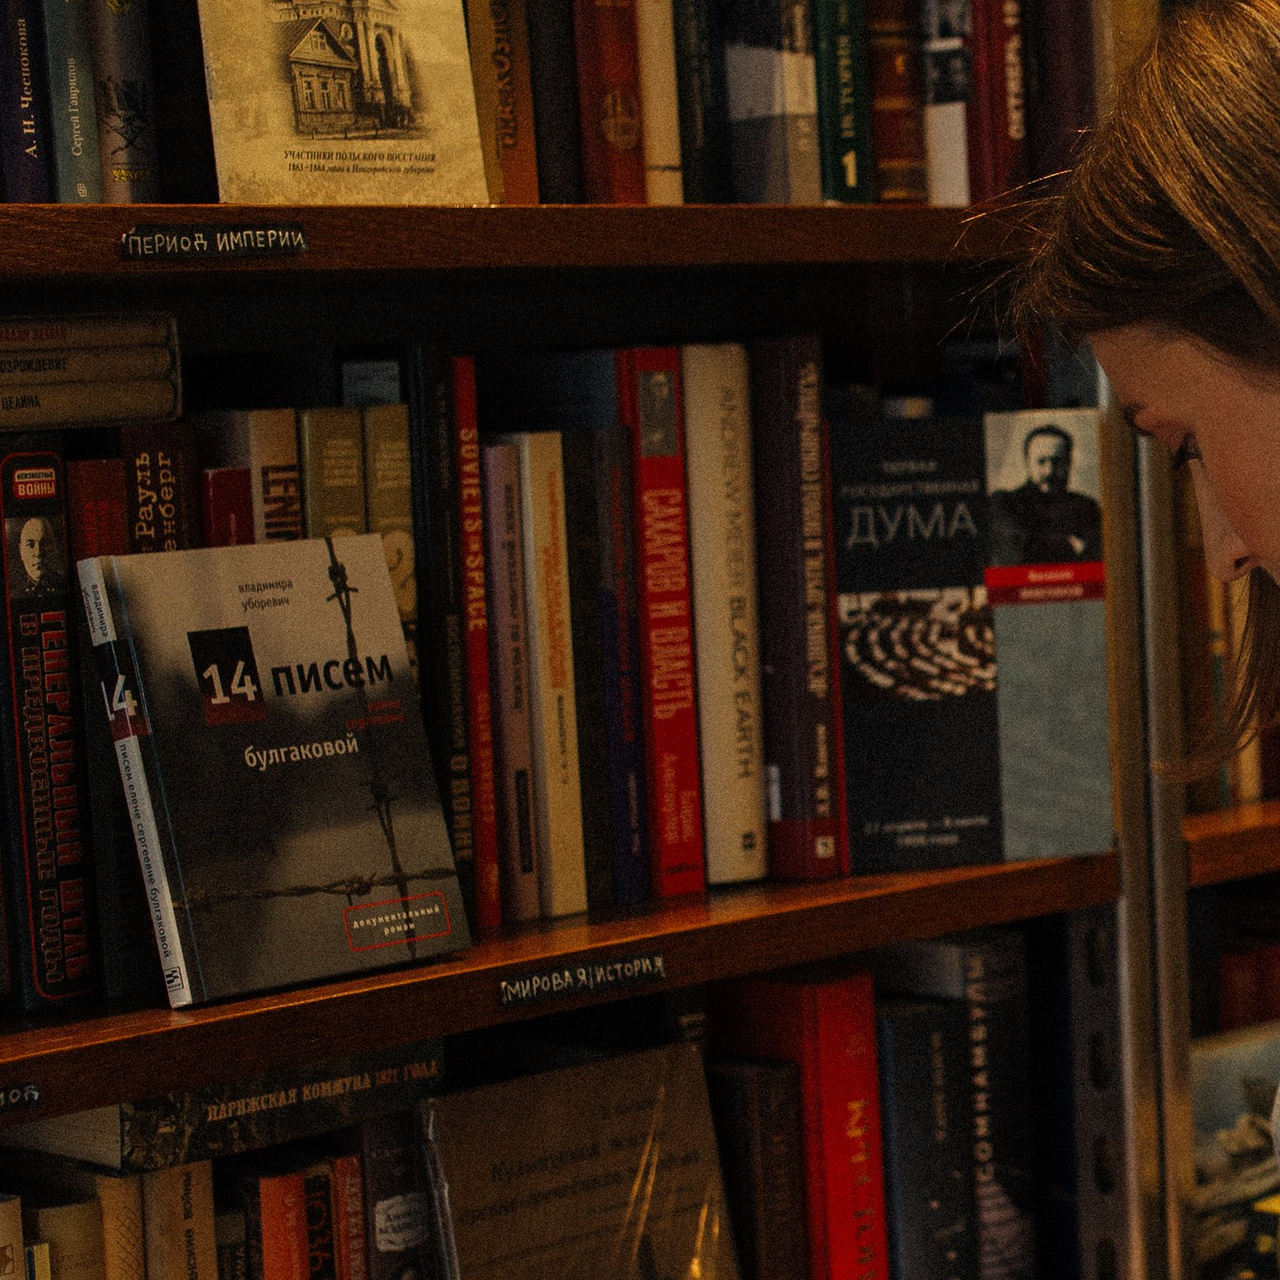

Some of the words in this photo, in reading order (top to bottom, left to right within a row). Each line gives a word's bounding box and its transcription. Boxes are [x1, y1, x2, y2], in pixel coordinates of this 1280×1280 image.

[14, 17, 36, 110] Чеснокова
[127, 230, 209, 258] ПЕРИОД
[215, 227, 307, 254] ИМПЕРИИ
[1, 394, 41, 411] ЦЕЛИНА
[459, 427, 483, 533] SOVIETS
[718, 386, 748, 502] ANDREW
[17, 482, 56, 496] ВОЙНЫ
[134, 451, 158, 541] Рауль
[157, 450, 178, 552] енберг
[840, 479, 981, 498] ГОСУДАРСТВЕННАЯ
[642, 487, 688, 593] САХАРОВ
[725, 510, 750, 588] MEIER
[845, 501, 979, 551] ДУМА
[238, 577, 293, 596] владимира
[241, 595, 291, 614] уборевич
[465, 554, 487, 632] SPACE
[648, 600, 686, 619] И
[19, 613, 41, 637] В
[728, 596, 753, 682] BLACK
[201, 658, 259, 706] 14
[271, 654, 395, 697] писем
[650, 626, 694, 720] ВЛАСТЬ
[22, 646, 60, 880] ПРЕДВОЕННЫЕ
[40, 610, 87, 868] ГЕНЕРАЛЬНЫЙ
[243, 731, 361, 773] булгаковой
[735, 691, 755, 780] EARTH
[450, 778, 474, 860] ВОЙНЕ
[37, 888, 66, 983] ГОДЫ
[58, 877, 90, 981] ШТАБ
[146, 888, 173, 960] булгаковой
[352, 904, 442, 929] документальный
[383, 921, 417, 938] роман
[593, 955, 665, 983] ИСТОРИЯ
[206, 1086, 298, 1123] ПАРИЖСКАЯ
[302, 1072, 372, 1102] КОММУНА
[402, 1059, 438, 1082] ГОДА
[179, 1170, 194, 1220] войны
